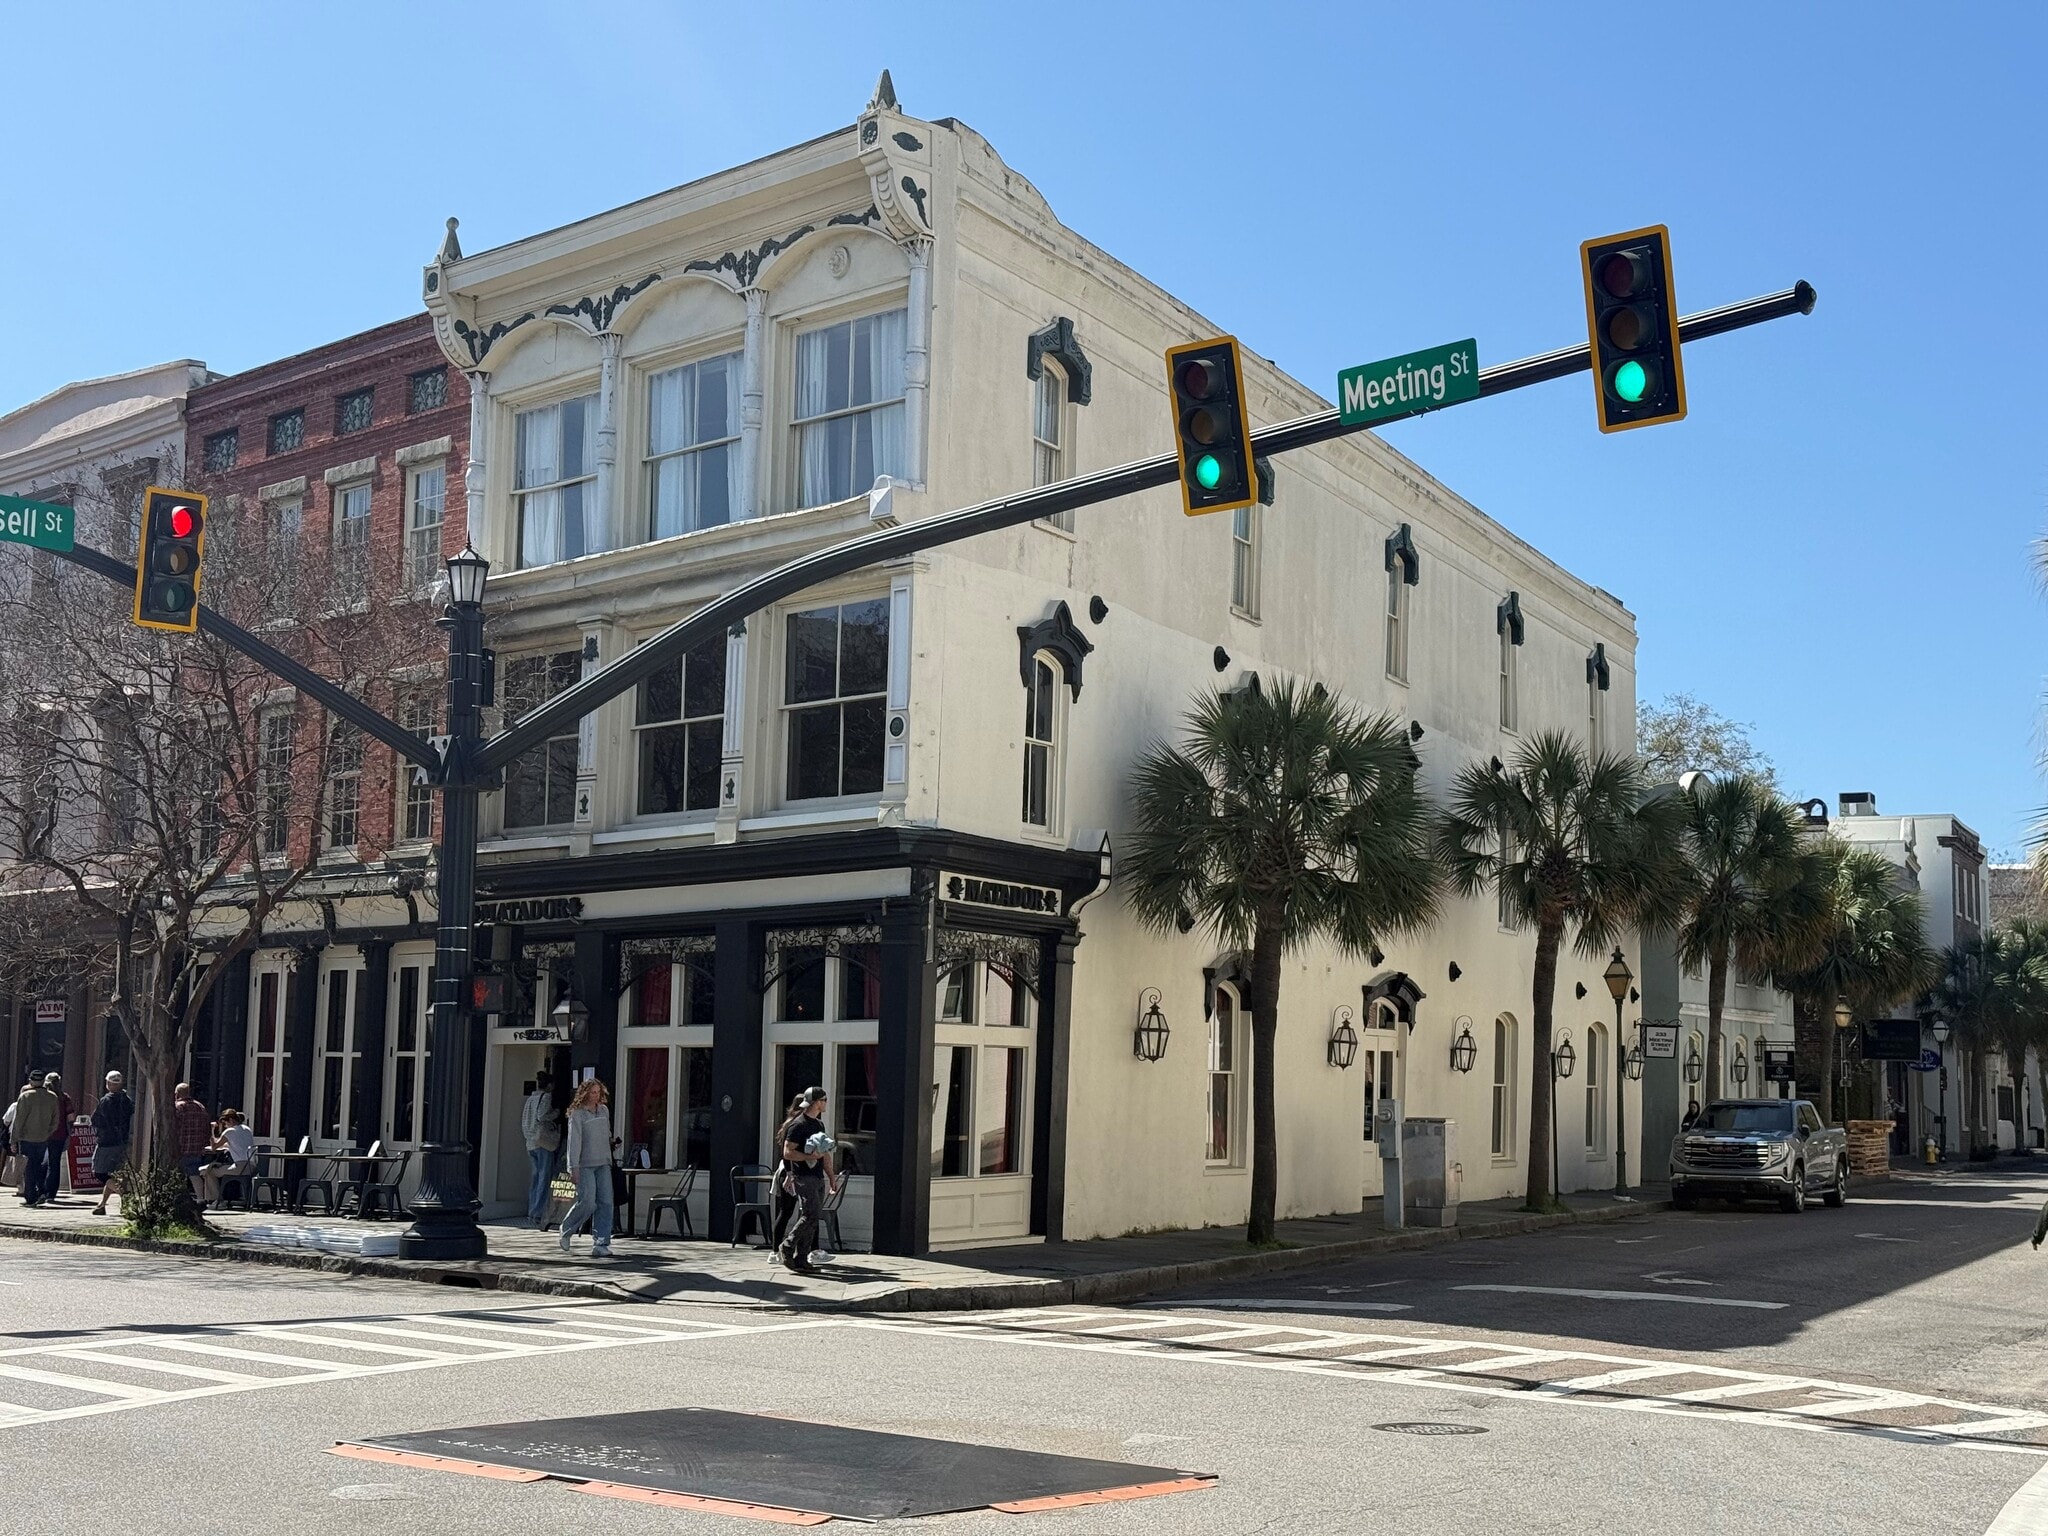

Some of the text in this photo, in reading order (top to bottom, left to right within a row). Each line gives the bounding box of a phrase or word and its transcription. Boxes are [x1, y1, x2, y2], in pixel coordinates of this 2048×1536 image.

[1343, 351, 1470, 414] Meeting St
[44, 511, 63, 533] St
[964, 879, 1044, 912] MATADOR
[480, 898, 569, 921] MATADOR
[38, 1003, 64, 1012] ATM
